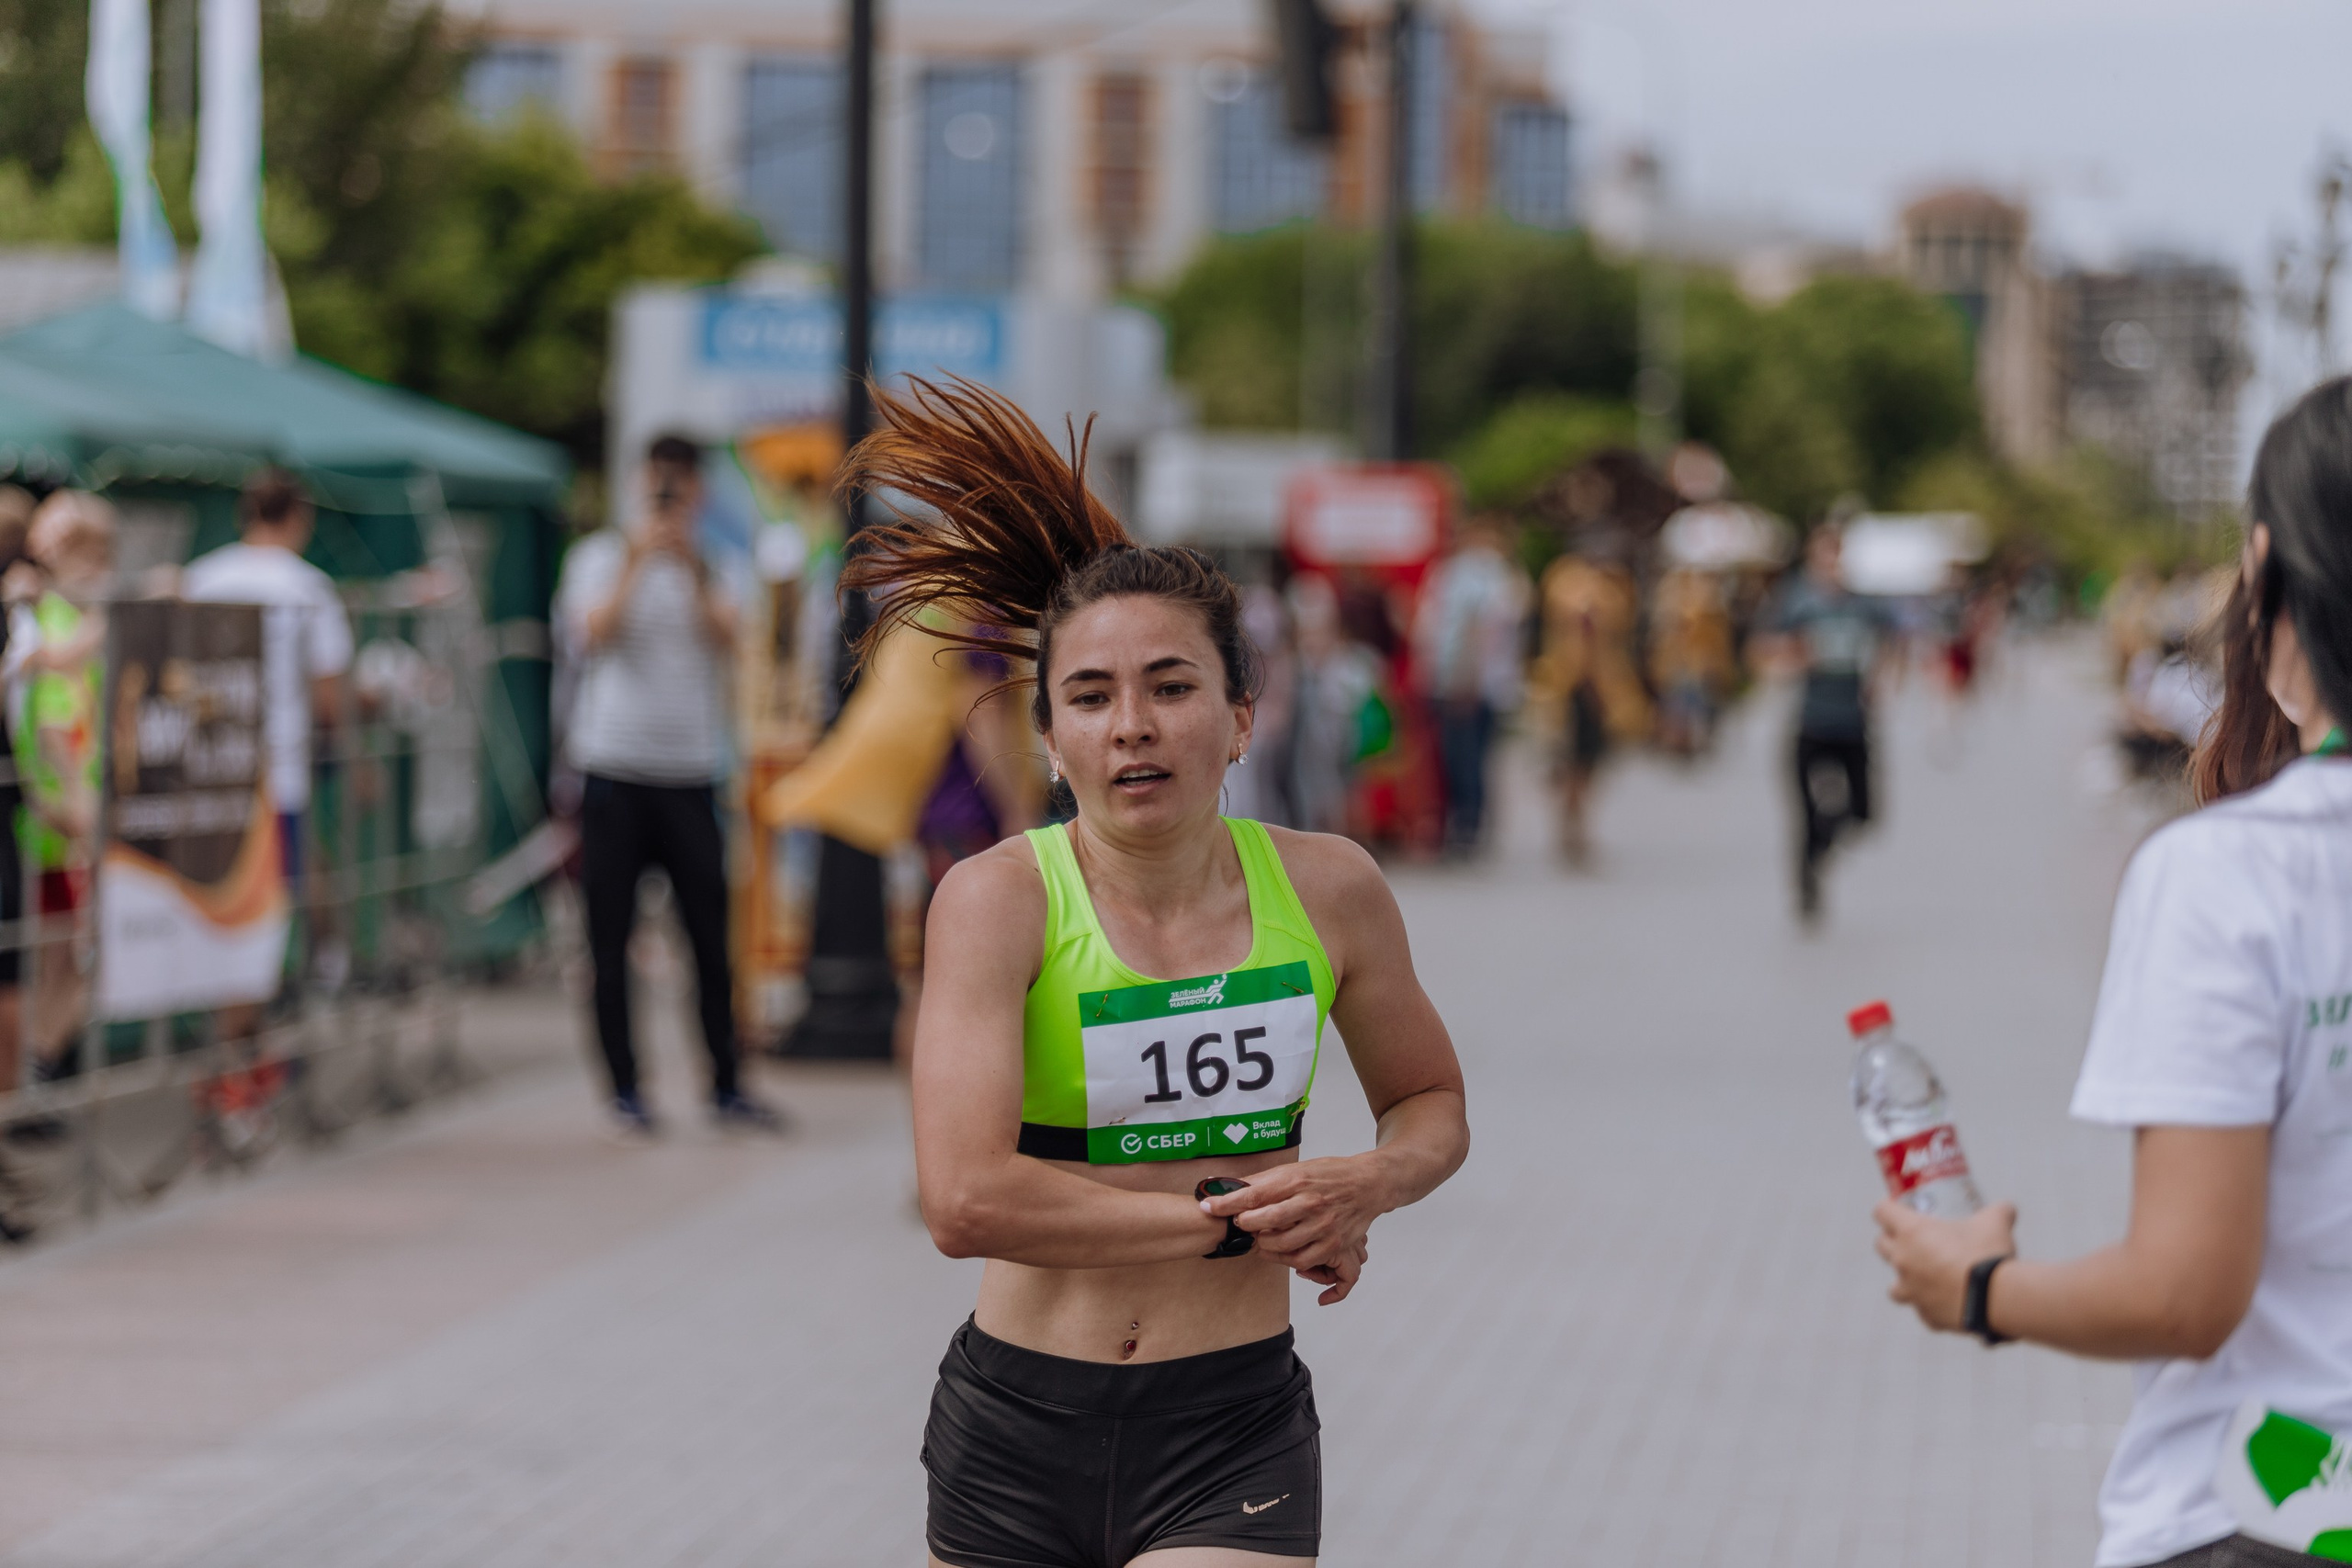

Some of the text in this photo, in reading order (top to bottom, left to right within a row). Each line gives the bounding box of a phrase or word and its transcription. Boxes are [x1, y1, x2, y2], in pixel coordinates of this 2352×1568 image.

[1170, 987, 1205, 998] ЗЕЛЁНЫЙ
[1170, 998, 1206, 1009] МАРАФОН
[1140, 1026, 1274, 1103] 165
[1252, 1120, 1281, 1130] Вклад
[1147, 1133, 1196, 1149] СБЕР
